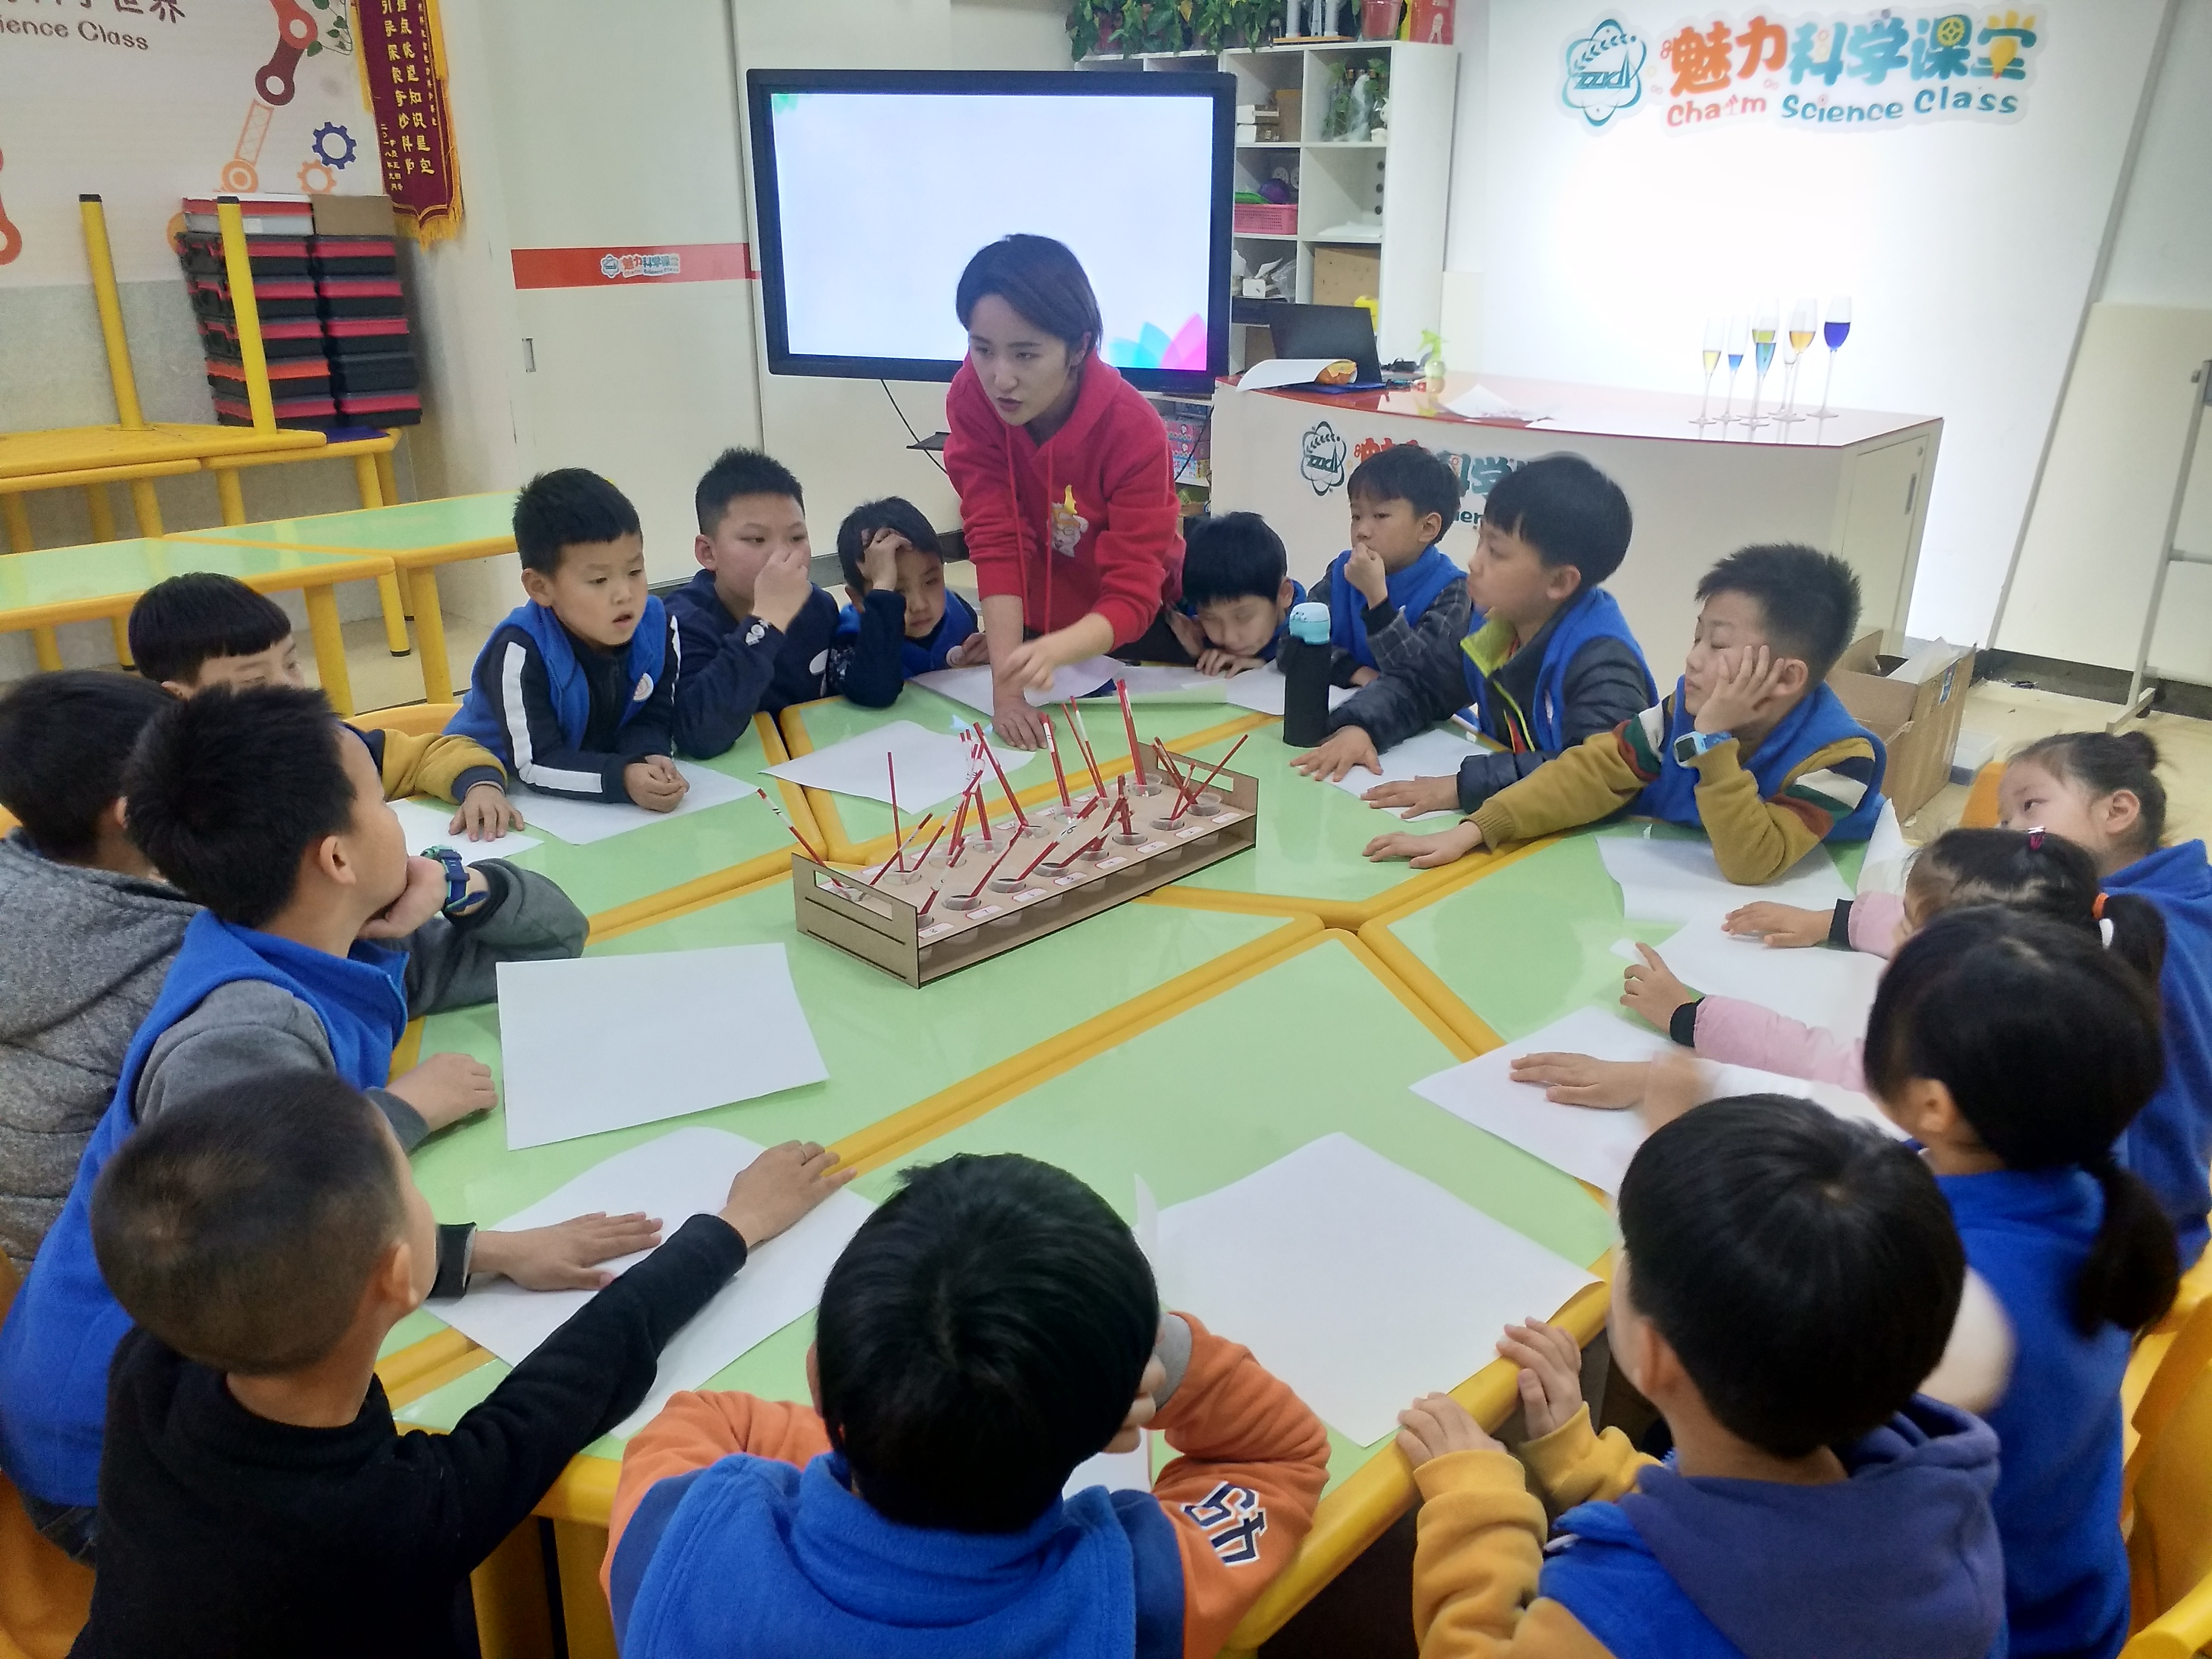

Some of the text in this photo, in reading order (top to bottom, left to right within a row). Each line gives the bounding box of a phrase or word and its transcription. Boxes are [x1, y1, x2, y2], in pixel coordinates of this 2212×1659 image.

[78, 21, 149, 50] Class
[1670, 9, 2037, 97] 魅力科学课堂
[1780, 94, 1904, 123] Science
[1913, 85, 2019, 115] Class
